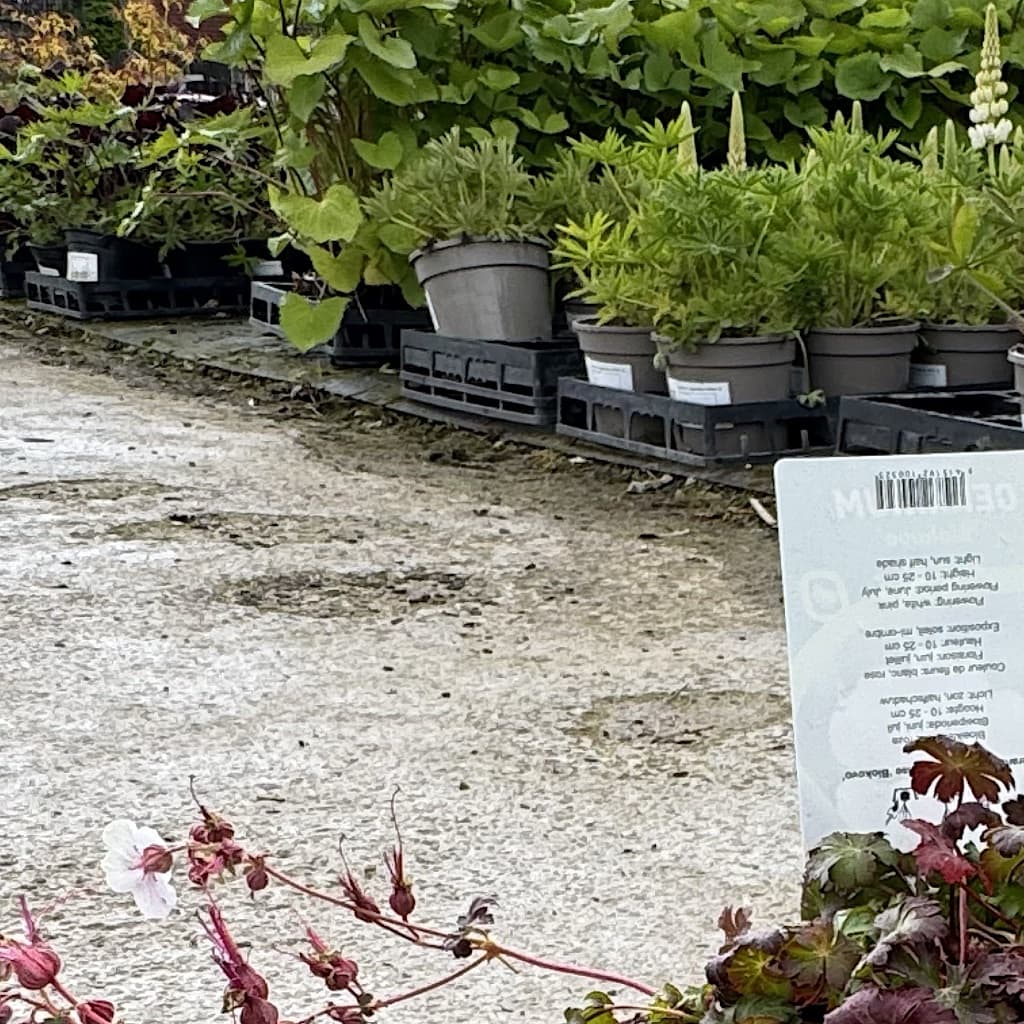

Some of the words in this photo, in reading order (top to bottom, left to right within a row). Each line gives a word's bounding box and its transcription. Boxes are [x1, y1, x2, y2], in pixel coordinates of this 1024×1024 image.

[910, 559, 927, 567] half
[930, 556, 950, 565] sun,
[954, 553, 980, 564] Light:
[876, 559, 907, 569] shade
[884, 573, 900, 582] cm
[903, 572, 915, 582] 25
[925, 571, 936, 581] 10
[940, 568, 975, 579] Height:
[885, 586, 911, 596] June,
[914, 583, 948, 594] period:
[952, 582, 998, 592] Flowering
[862, 587, 881, 598] July
[879, 600, 899, 611] pink
[903, 600, 930, 610] white,
[936, 596, 984, 608] Flowering:
[916, 626, 943, 636] soleil,
[947, 621, 999, 633] Exposition:
[865, 628, 912, 639] mi-ombre
[885, 642, 900, 651] cm
[903, 641, 915, 651] 25
[925, 640, 937, 649] 10
[941, 637, 982, 648] Hauteur:
[885, 654, 910, 665] juillet
[914, 652, 933, 663] juin,
[938, 651, 983, 661] Floraison:
[921, 666, 950, 676] fleurs:
[953, 665, 965, 674] de
[968, 662, 1005, 673] Couleur
[864, 671, 885, 680] rose
[889, 668, 918, 679] blanc,
[944, 692, 964, 701] zon,
[968, 689, 993, 700] Licht:
[880, 694, 941, 707] halfschaduw
[909, 708, 921, 718] 25
[931, 707, 943, 716] 10
[946, 704, 984, 714] Hoogte:
[891, 710, 906, 719] cm
[888, 722, 901, 734] juli
[904, 720, 923, 732] juni,
[926, 717, 989, 729] Bloeiperiode:
